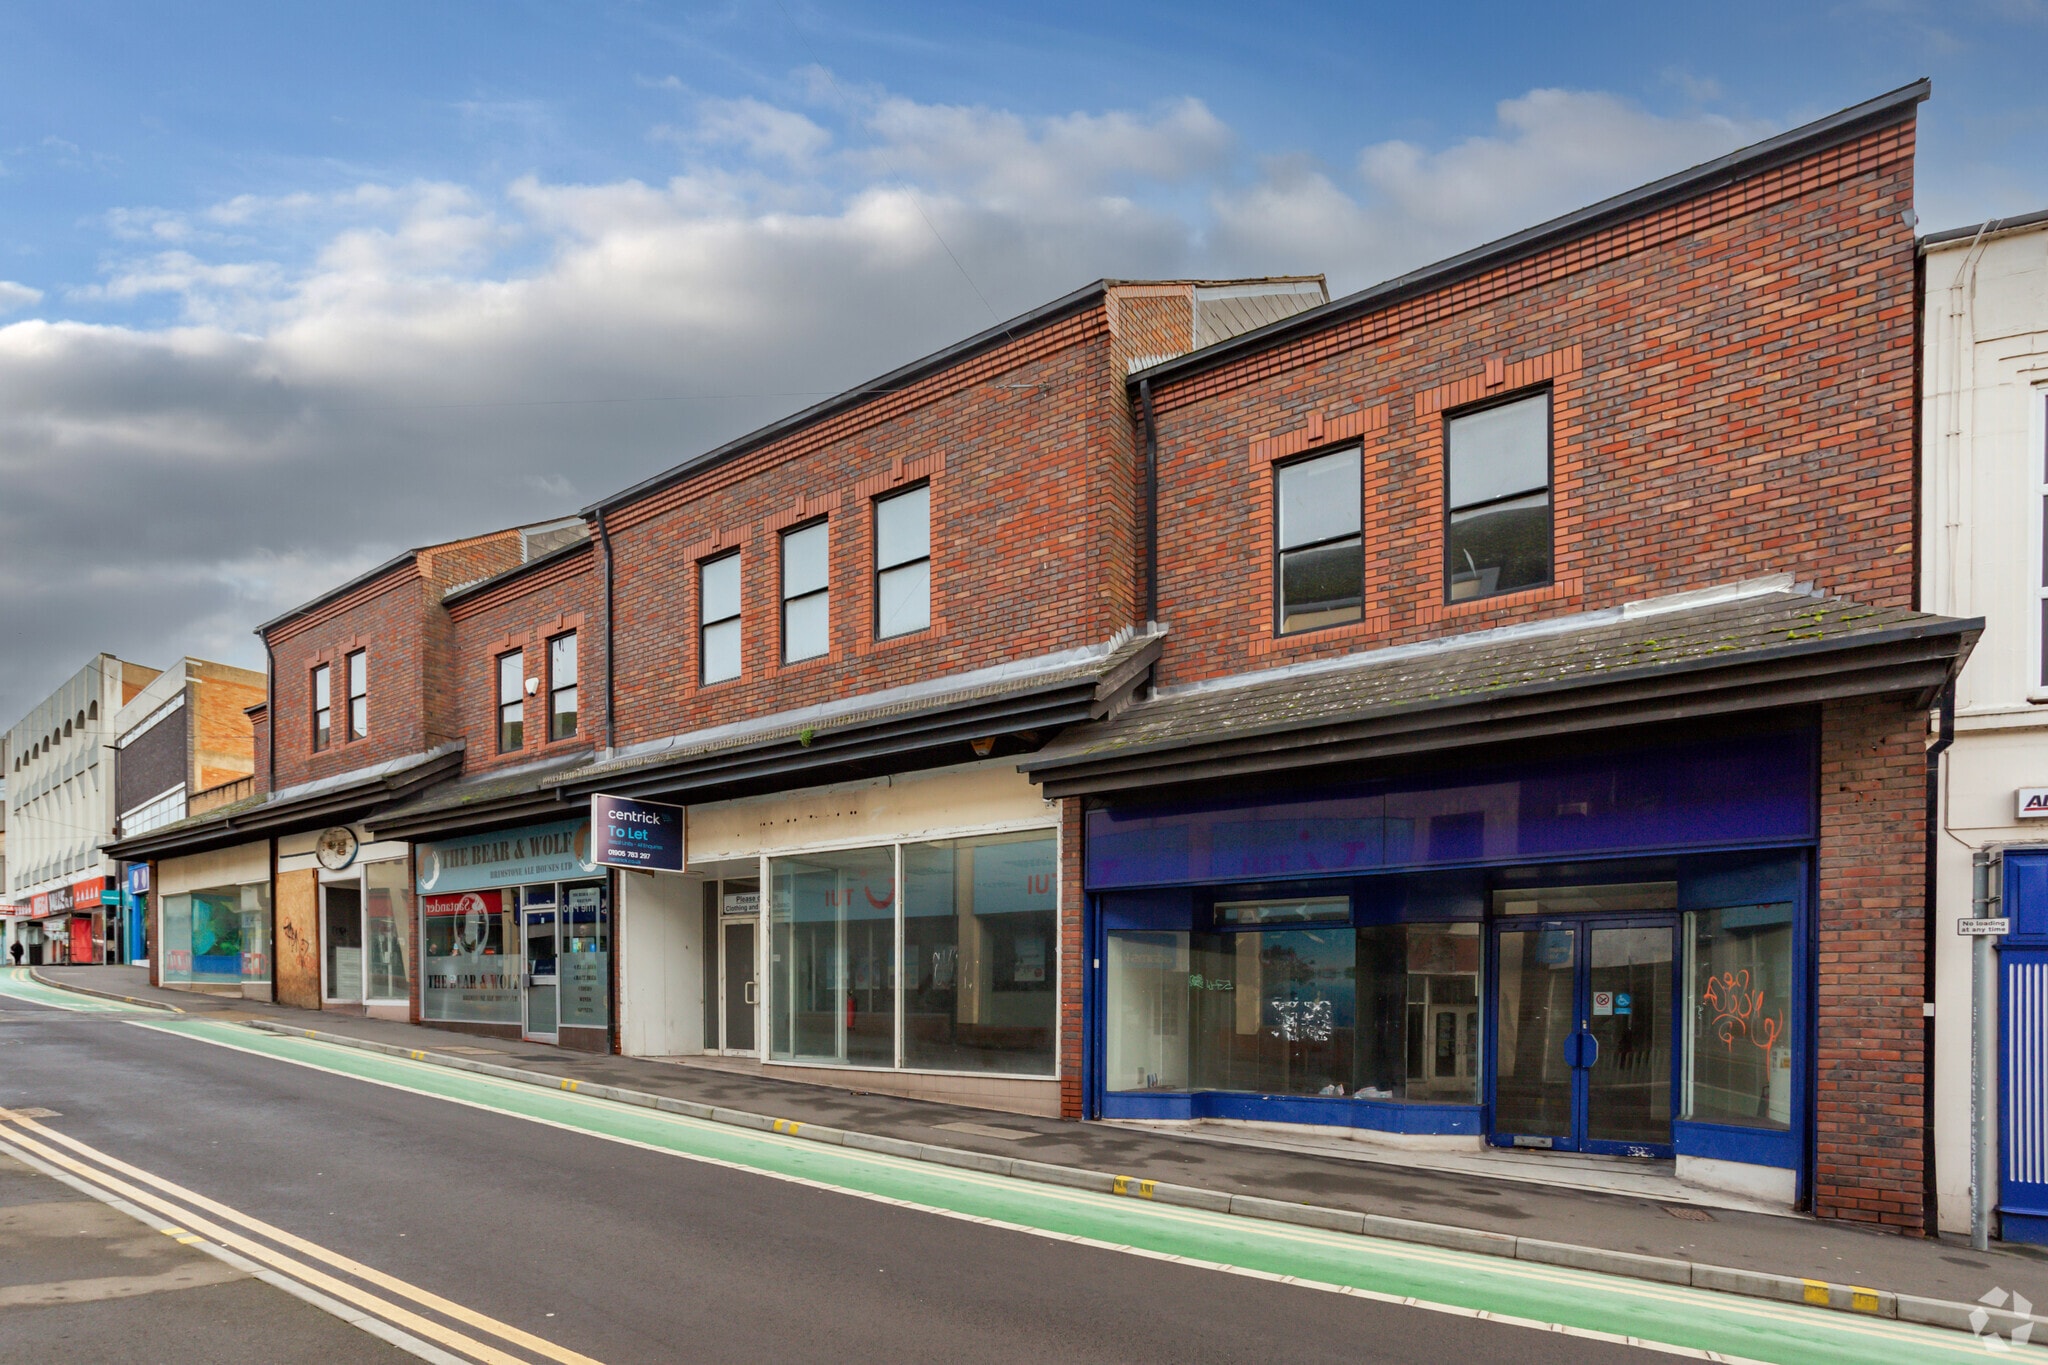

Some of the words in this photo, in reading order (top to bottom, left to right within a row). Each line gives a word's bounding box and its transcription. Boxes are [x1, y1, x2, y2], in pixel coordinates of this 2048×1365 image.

[607, 809, 660, 825] centrick
[607, 824, 626, 838] To
[627, 827, 649, 841] Let
[442, 847, 469, 869] THE
[471, 841, 510, 865] BEAR
[514, 839, 525, 859] &
[529, 831, 573, 856] WOLF
[490, 867, 522, 879] BRIMSTONE
[524, 866, 534, 875] ALE
[561, 862, 573, 871] LTD
[735, 895, 756, 903] Please
[725, 904, 748, 912] Clothing
[427, 974, 448, 989] THE
[480, 974, 488, 990] &
